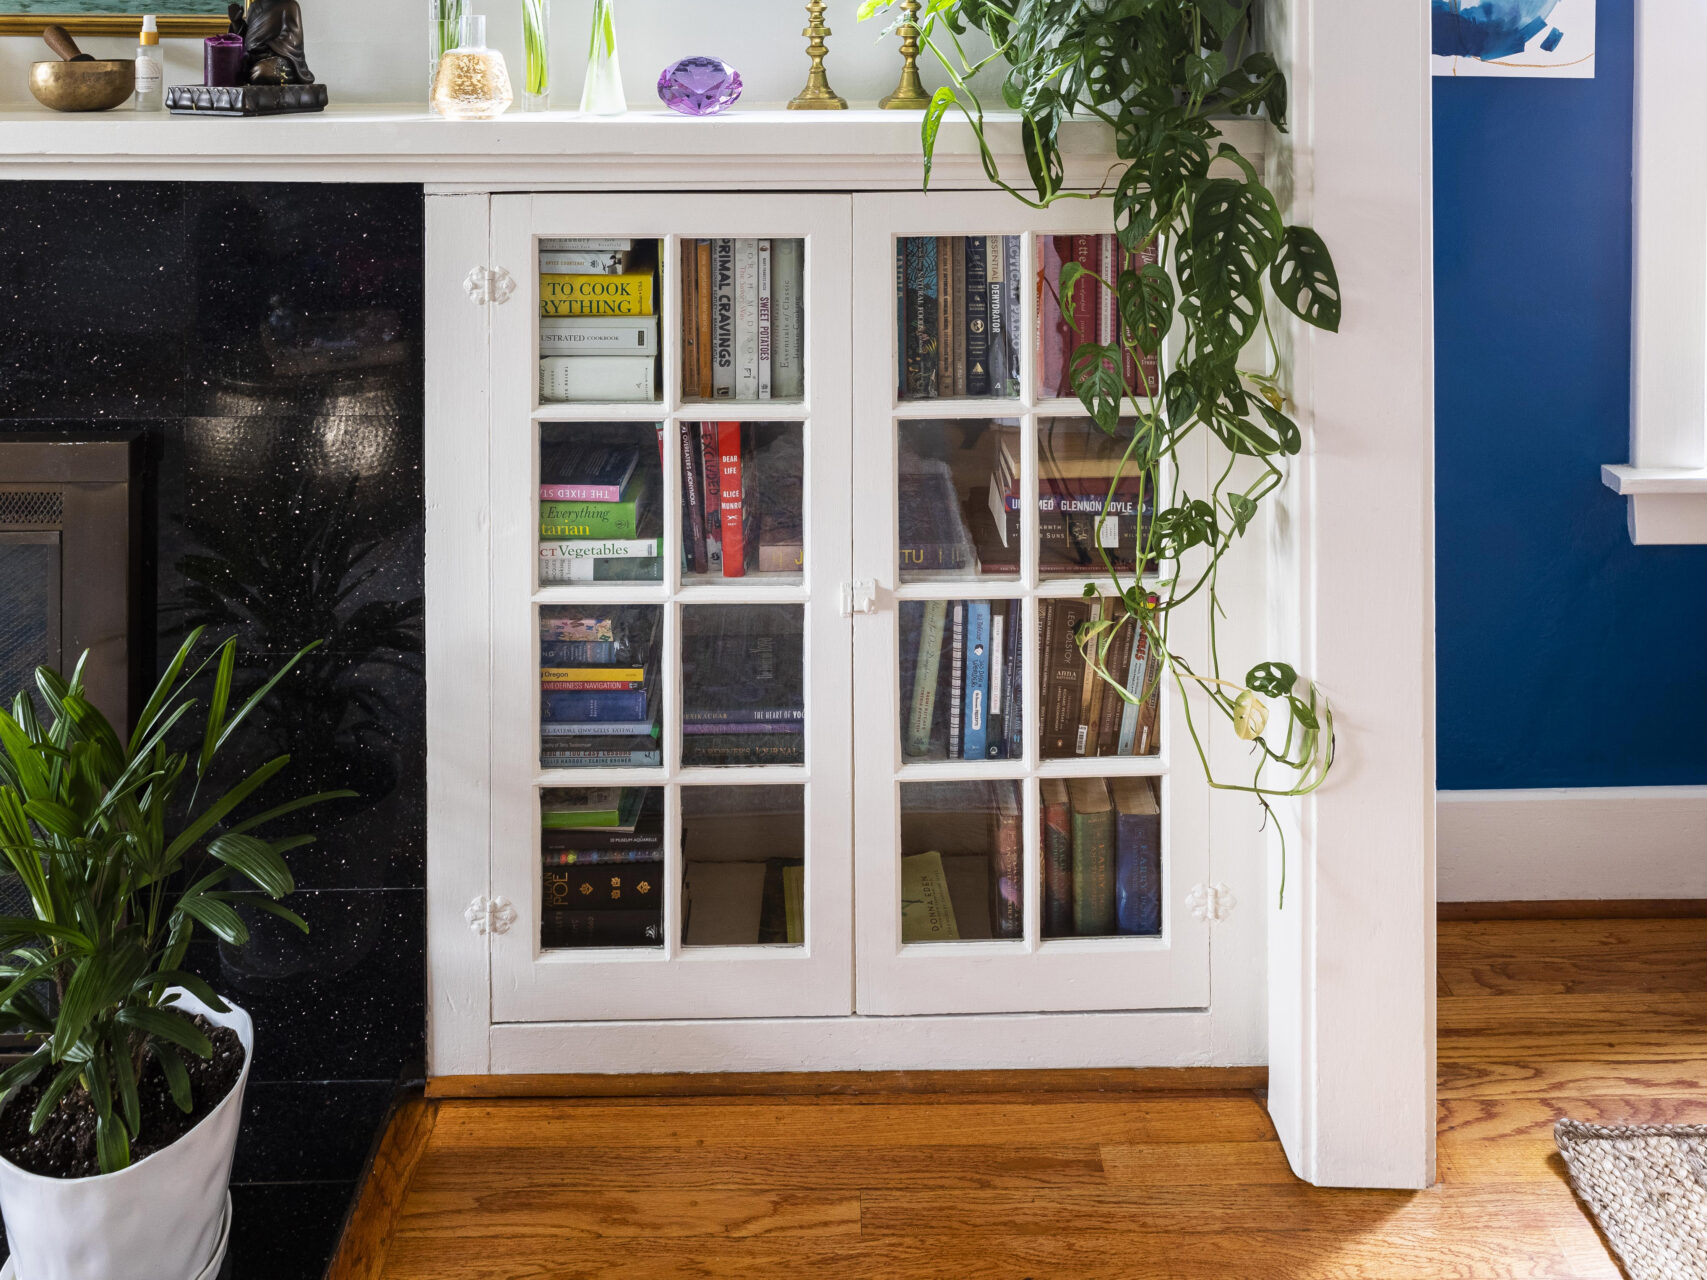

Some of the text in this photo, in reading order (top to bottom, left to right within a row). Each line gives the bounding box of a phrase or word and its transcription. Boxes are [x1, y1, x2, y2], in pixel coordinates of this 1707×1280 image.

[1078, 237, 1089, 263] ette
[547, 282, 632, 296] TO COOK
[917, 271, 925, 305] NATURAL
[990, 236, 1001, 333] ESSENTIAL DEHYDRATOR
[541, 300, 632, 314] RYTHING
[917, 306, 925, 331] FOODS
[718, 294, 732, 368] CRAVINGS
[759, 296, 769, 361] SWEET POTATOES
[779, 280, 792, 369] Essentials of Classic
[1009, 303, 1020, 349] PALEO
[682, 434, 696, 505] OVEREATERS ANONYMOUS
[702, 433, 720, 495] EXCLUDED
[722, 455, 738, 463] DEAR
[557, 489, 586, 499] FIXED
[590, 489, 609, 499] THE
[723, 490, 739, 498] ALICE
[1061, 500, 1102, 512] GLENNON
[547, 506, 611, 522] Everything
[541, 520, 590, 535] tarian
[558, 544, 629, 558] Vegetables
[1063, 611, 1076, 664] LEO TOLSTOY
[543, 681, 622, 689] WILDERNESS NAVIGATION
[754, 711, 763, 719] THE
[765, 711, 782, 720] HEART
[784, 711, 791, 719] OF
[553, 872, 568, 904] POE
[921, 875, 940, 932] DONNA EDEN
